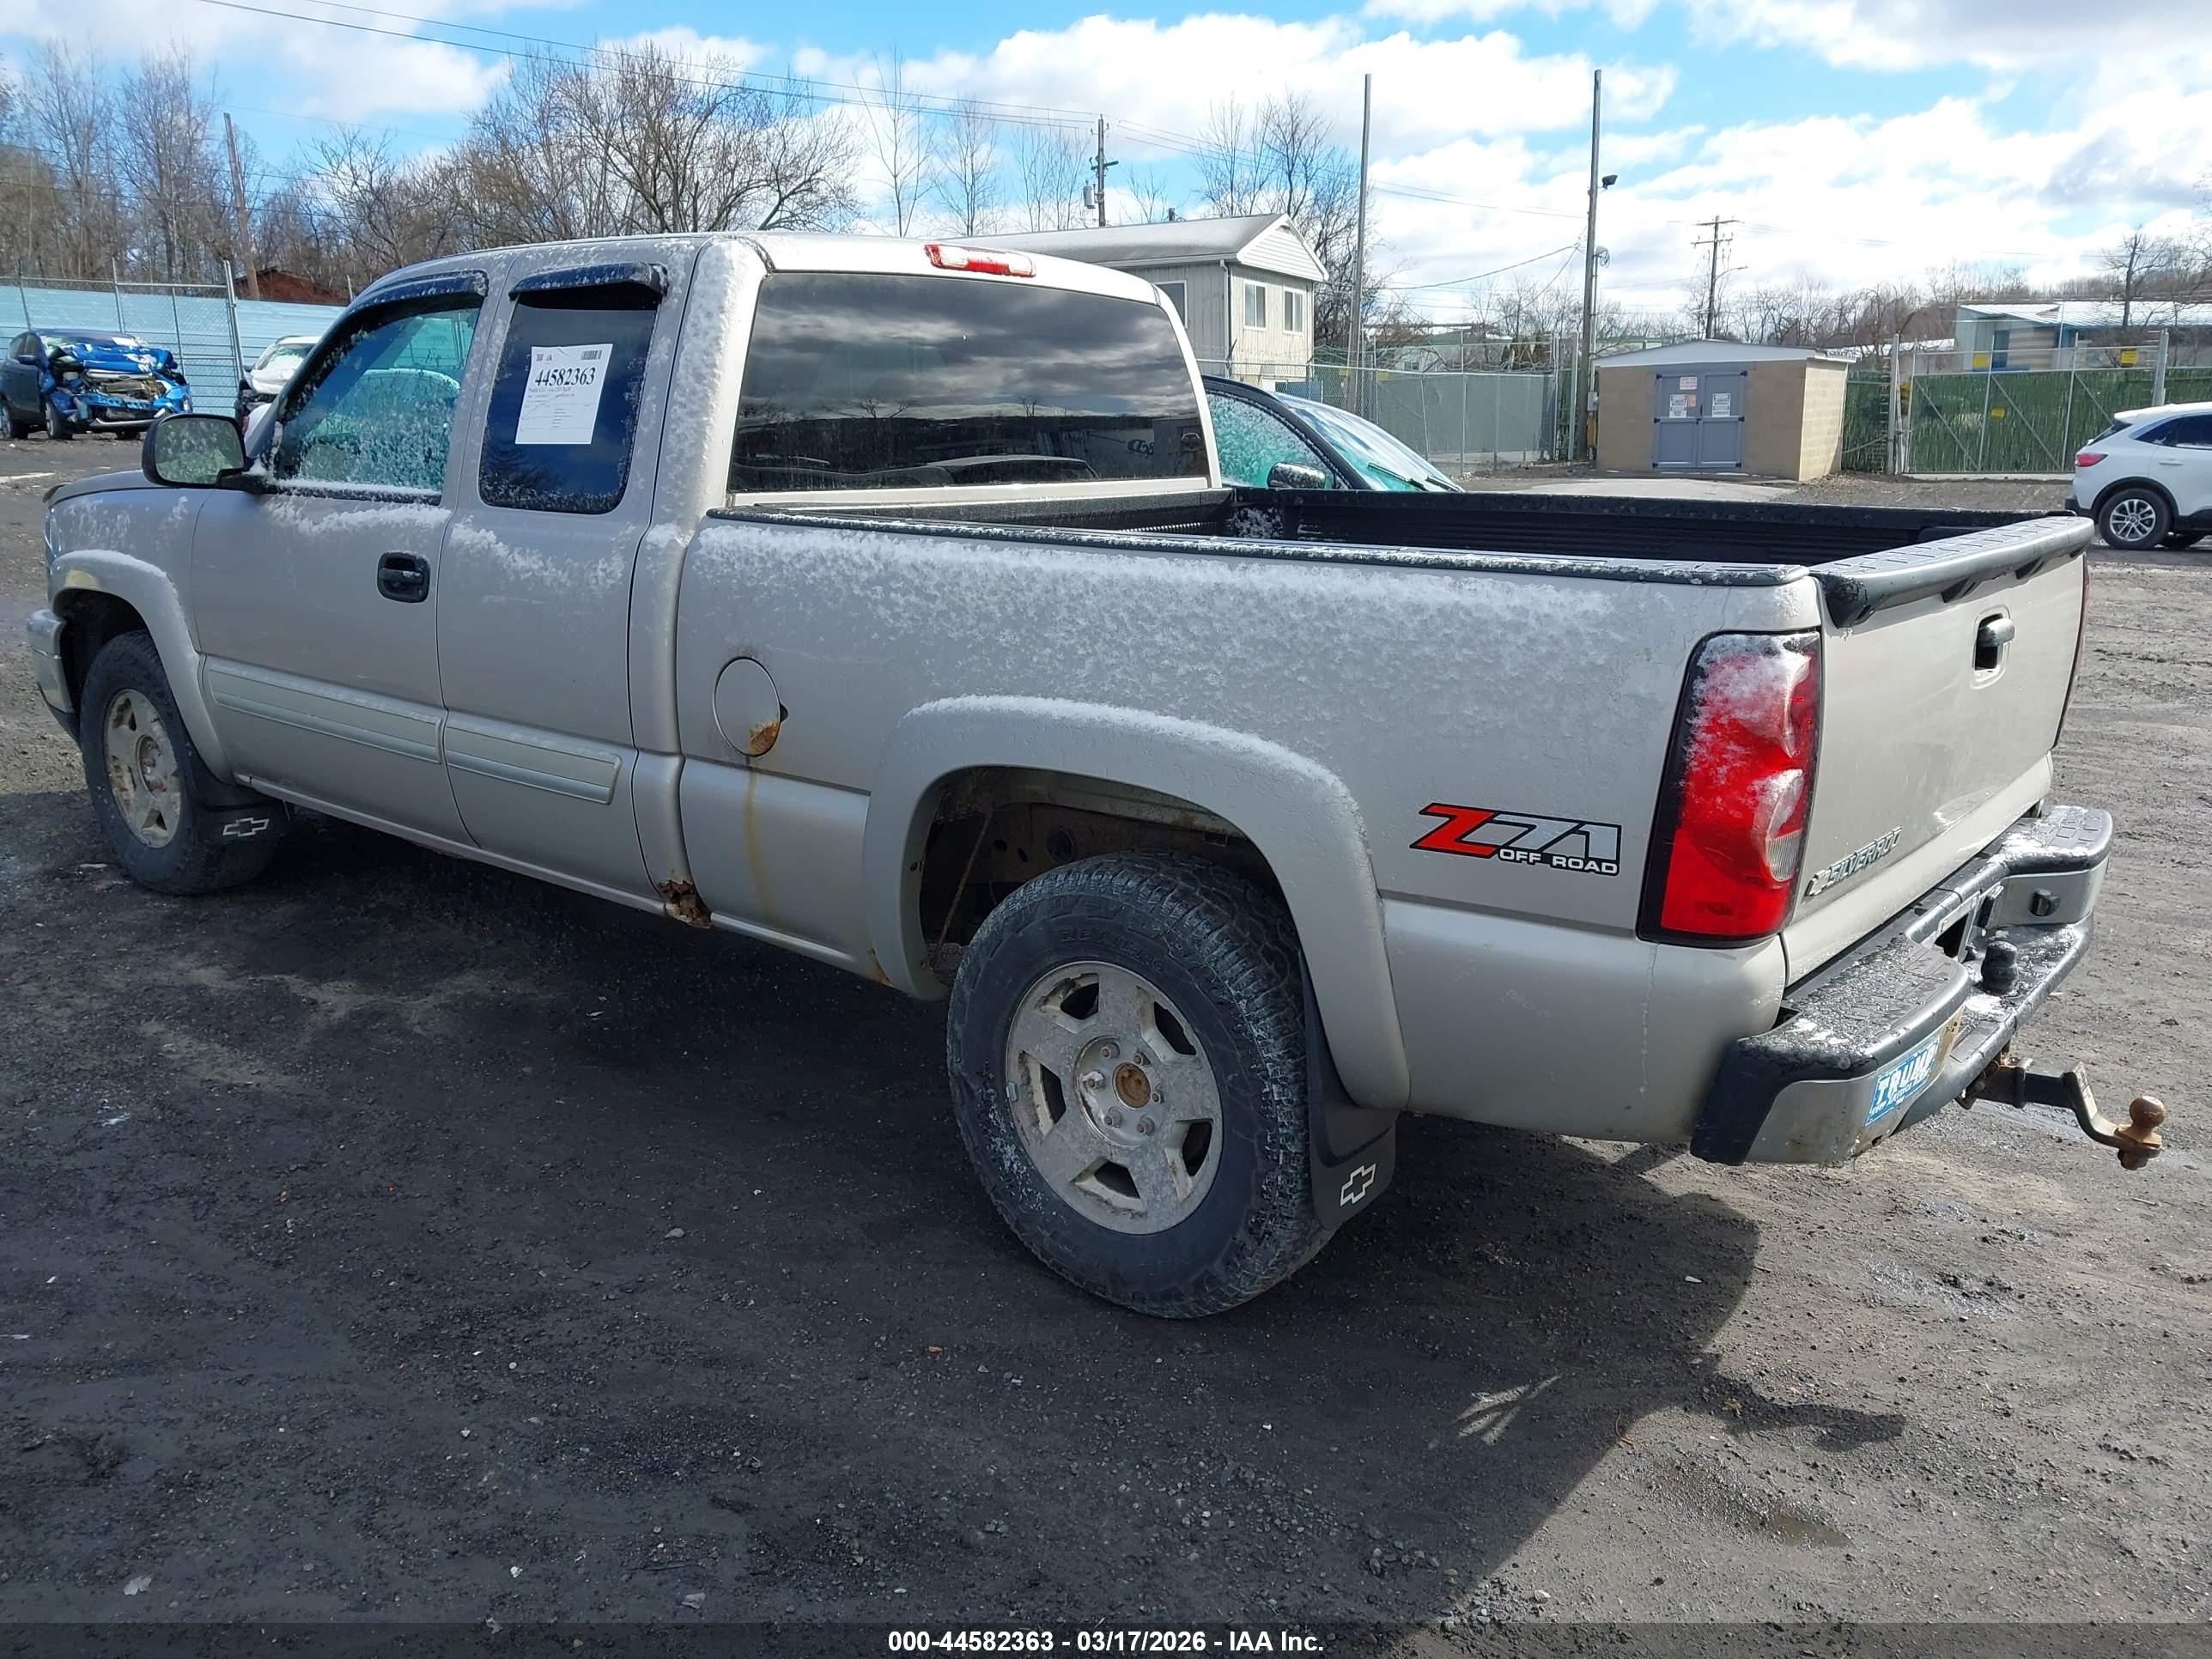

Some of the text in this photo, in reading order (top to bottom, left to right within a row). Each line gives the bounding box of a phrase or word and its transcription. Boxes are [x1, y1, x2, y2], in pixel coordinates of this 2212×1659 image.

[535, 367, 596, 386] 44582363
[1409, 802, 1622, 860] Z71
[1499, 848, 1619, 876] OFF ROAD
[1826, 826, 1903, 888] SILVERADO
